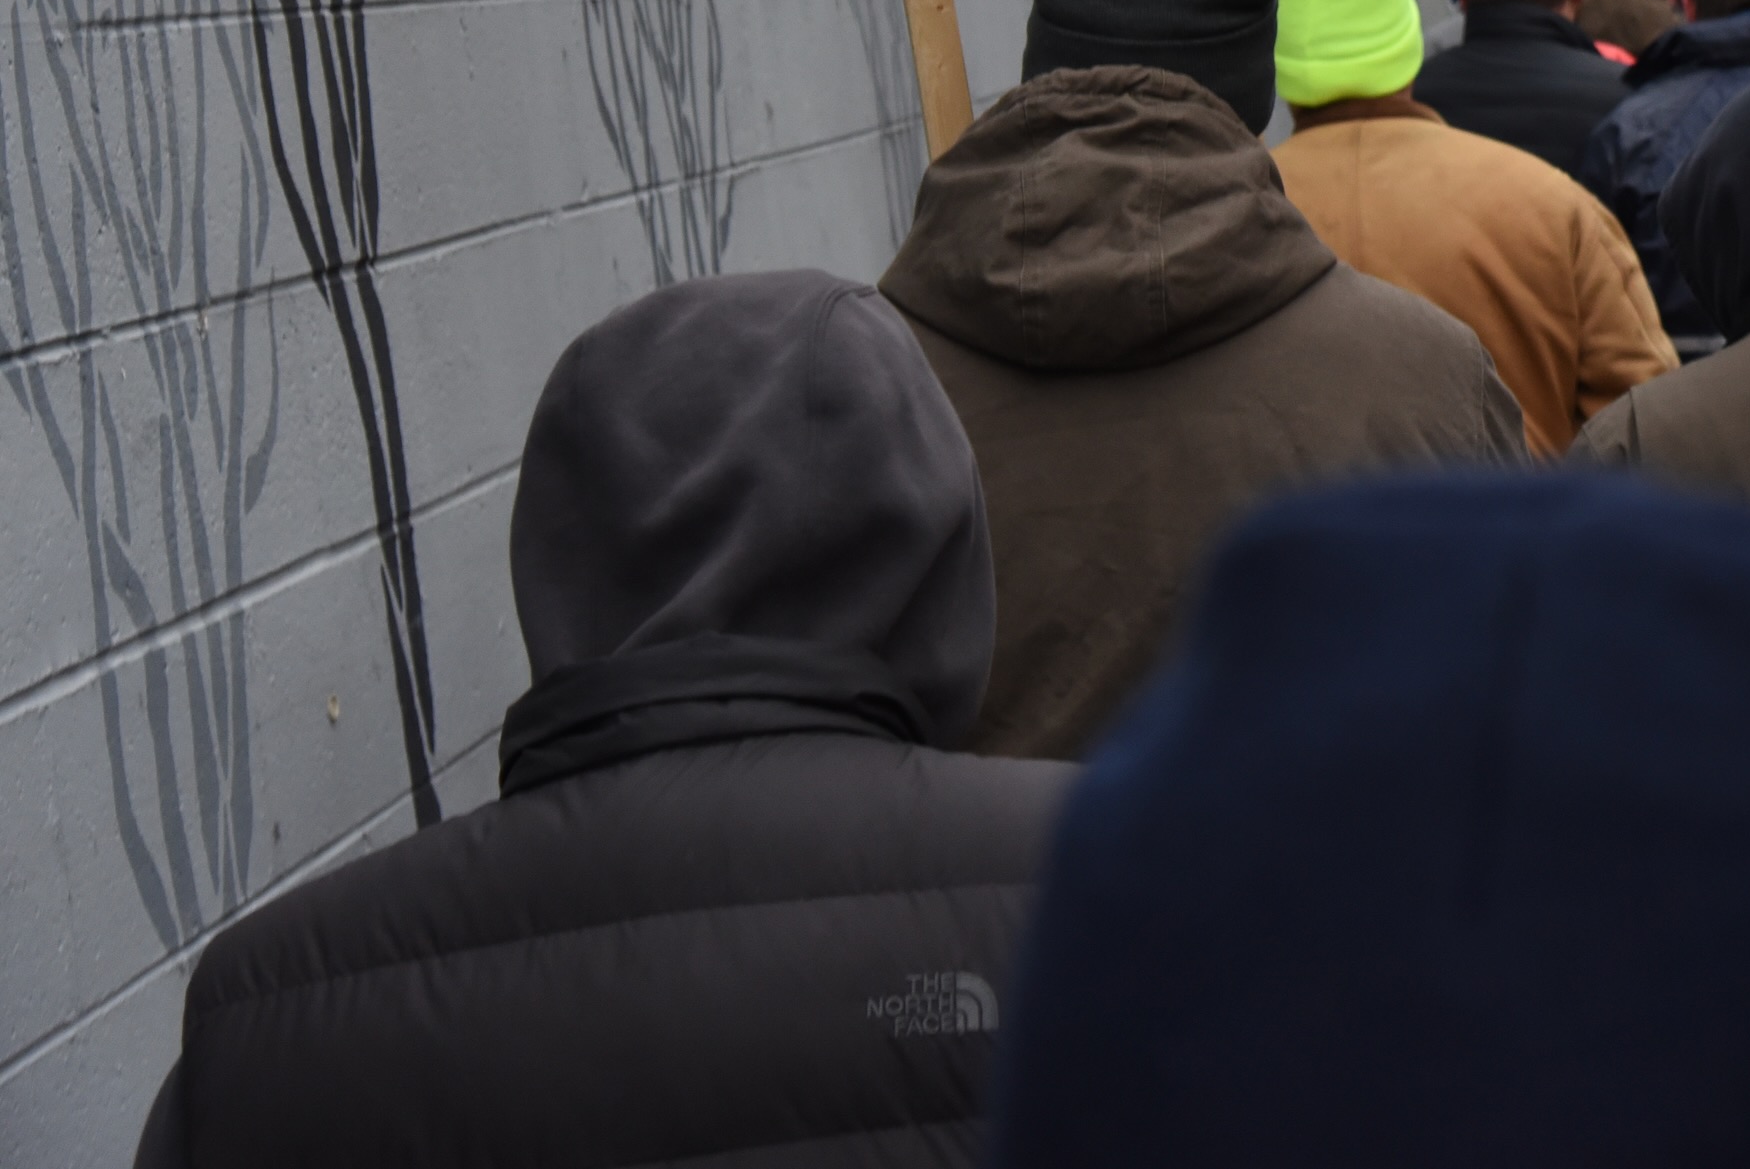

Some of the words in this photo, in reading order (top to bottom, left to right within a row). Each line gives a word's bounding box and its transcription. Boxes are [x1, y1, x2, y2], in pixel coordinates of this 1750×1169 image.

[905, 972, 954, 993] THE
[866, 993, 954, 1019] NORTH
[894, 1013, 954, 1039] FACE
